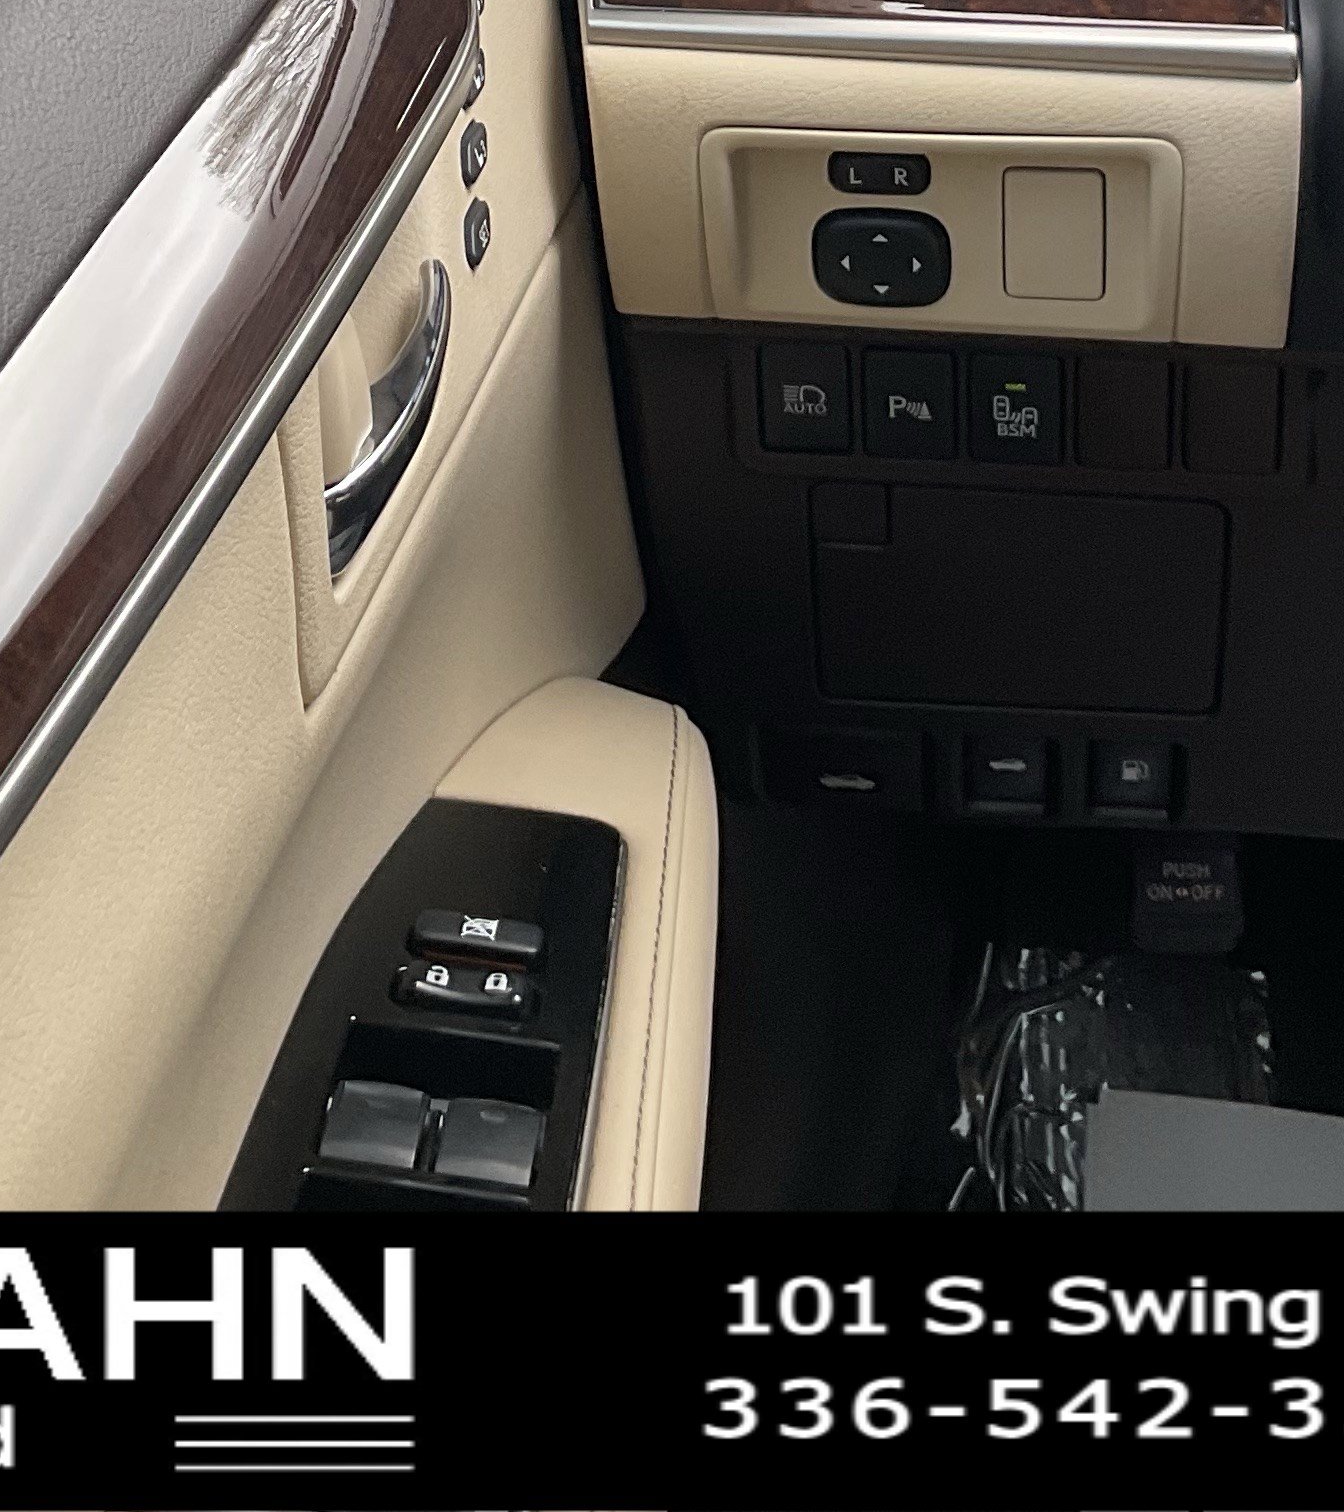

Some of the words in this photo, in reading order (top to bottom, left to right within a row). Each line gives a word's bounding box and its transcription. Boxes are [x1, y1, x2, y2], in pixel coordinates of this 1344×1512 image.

[849, 167, 862, 184] L
[893, 167, 909, 186] R
[783, 402, 827, 416] AUTO
[888, 396, 906, 420] P
[997, 423, 1037, 438] BSM
[1162, 862, 1210, 879] PUSH
[1146, 884, 1173, 901] ON
